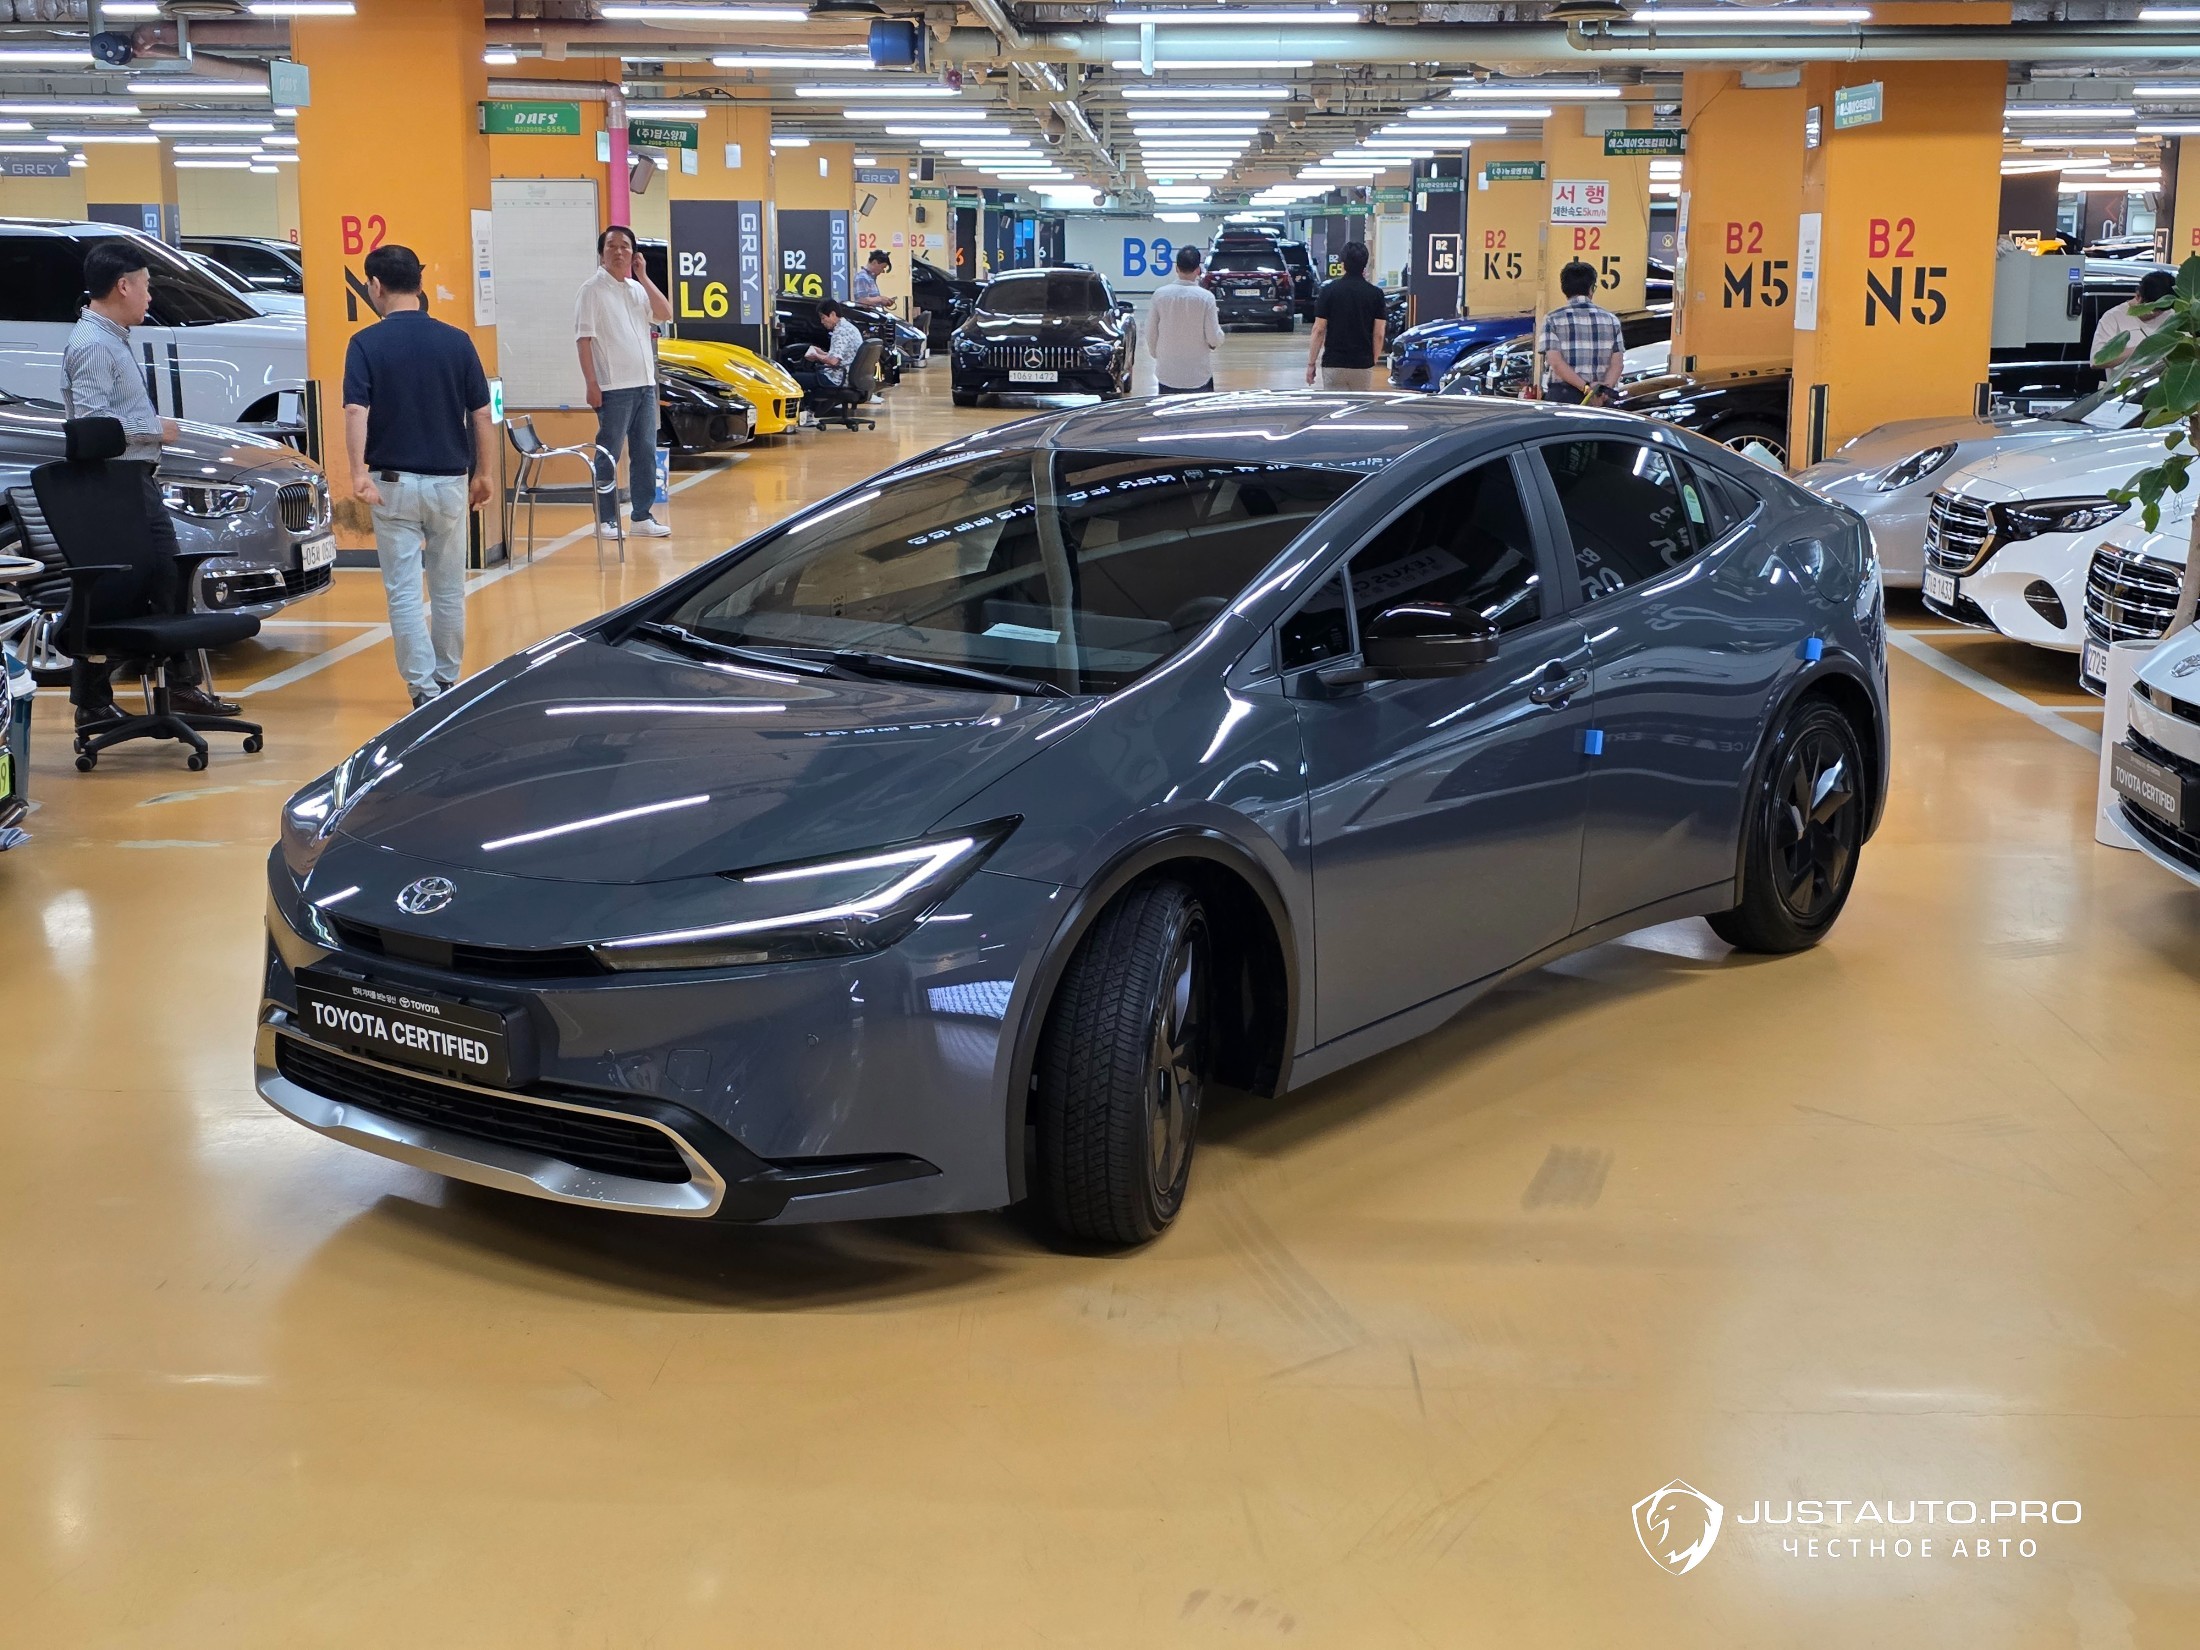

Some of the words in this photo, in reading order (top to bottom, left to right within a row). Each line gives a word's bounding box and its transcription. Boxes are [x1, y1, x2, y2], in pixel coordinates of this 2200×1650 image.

[514, 112, 558, 124] DAFS
[12, 164, 57, 175] GREY
[862, 174, 896, 182] GREY
[342, 214, 386, 255] B2
[859, 233, 876, 248] B2
[911, 234, 925, 247] B2
[1435, 239, 1448, 250] B2
[1485, 229, 1507, 249] B2
[1573, 227, 1601, 251] B2
[1726, 221, 1764, 254] B2
[1868, 217, 1915, 258] B2
[679, 252, 707, 276] B2
[784, 250, 806, 270] B2
[1123, 237, 1173, 276] B3
[1435, 254, 1454, 269] J5
[1484, 252, 1522, 280] K5
[784, 273, 823, 298] K6
[1723, 260, 1789, 308] M5
[1864, 266, 1948, 326] N5
[680, 281, 729, 318] L6
[2115, 765, 2142, 794] TOYOTA
[2142, 780, 2176, 813] CERTIFIED
[410, 999, 441, 1015] TOYOTA
[311, 1001, 389, 1042] TOYOTA
[391, 1021, 489, 1065] CERTIFIED
